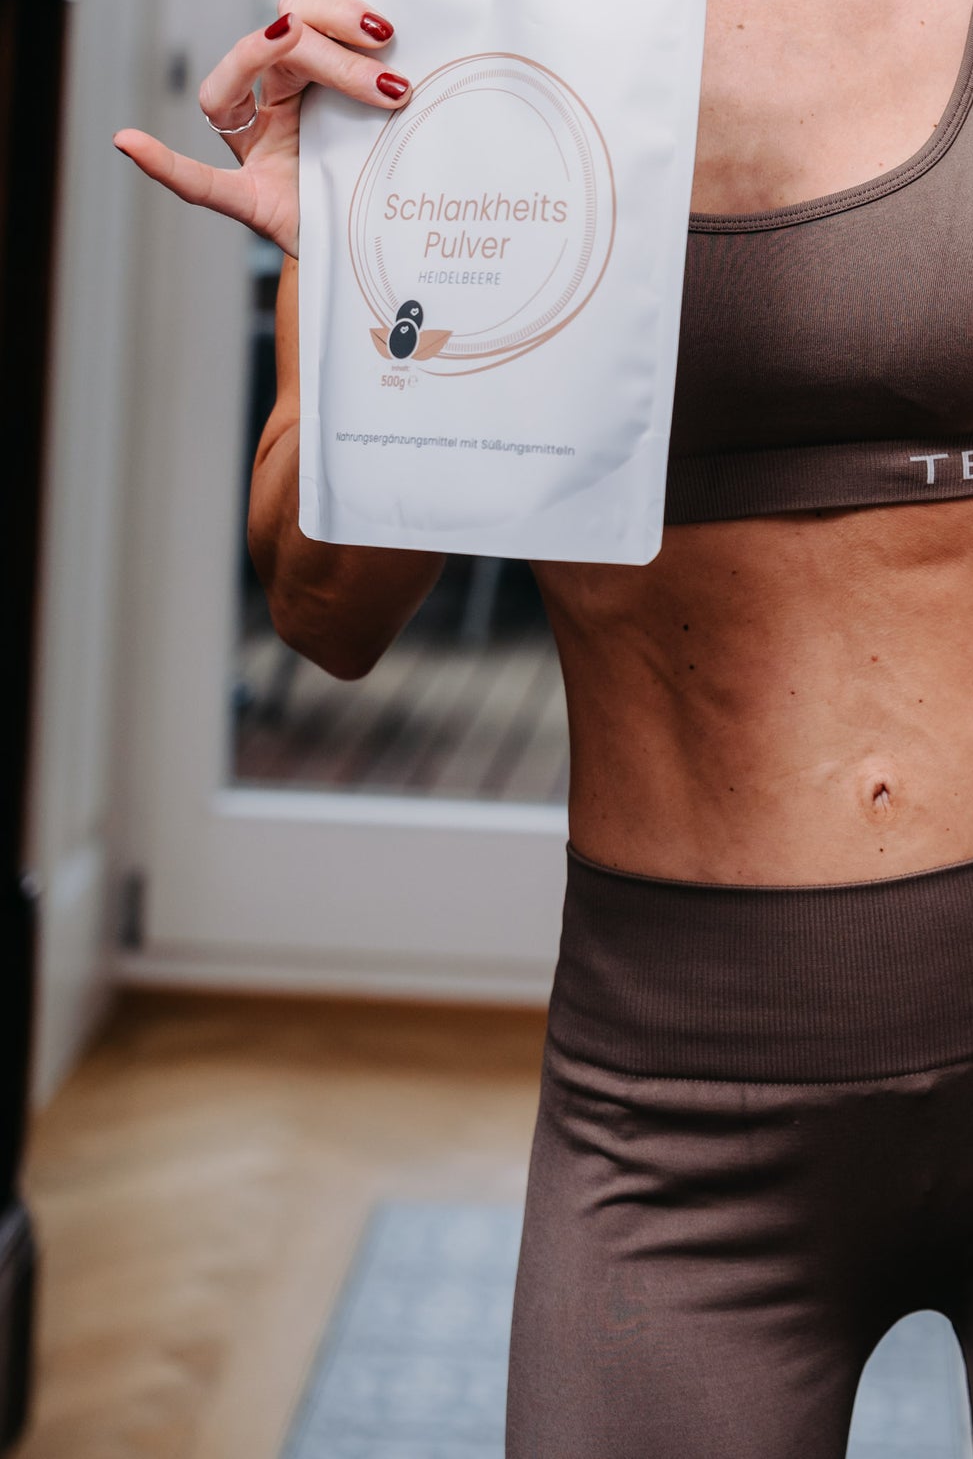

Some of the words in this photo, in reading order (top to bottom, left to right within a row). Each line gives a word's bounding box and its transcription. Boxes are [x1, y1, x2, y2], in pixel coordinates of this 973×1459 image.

[384, 192, 568, 223] Schlankheits
[424, 230, 511, 259] Pulver
[418, 271, 502, 286] HEIDELBEERE
[381, 374, 406, 391] 500g
[335, 431, 458, 449] Nahrungsergänzungsmittel
[460, 438, 478, 449] mit
[481, 439, 576, 456] Süßungsmitteln
